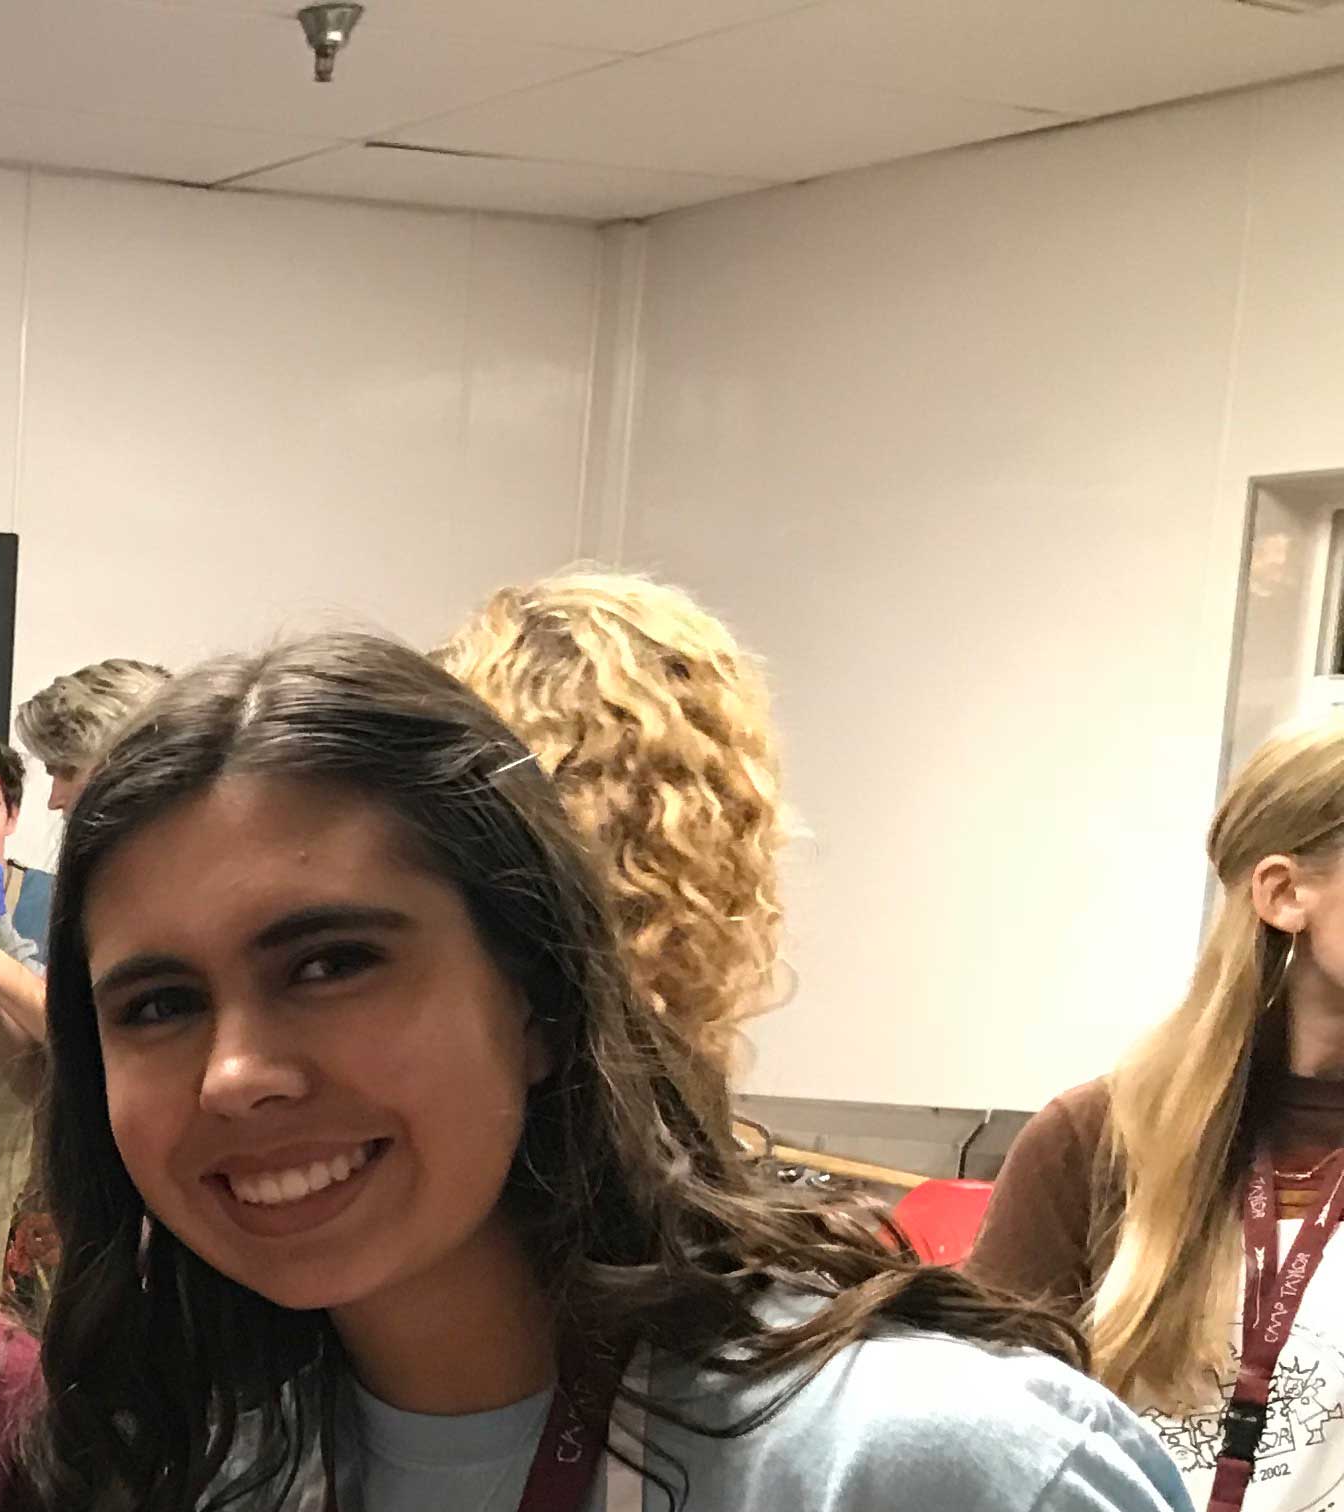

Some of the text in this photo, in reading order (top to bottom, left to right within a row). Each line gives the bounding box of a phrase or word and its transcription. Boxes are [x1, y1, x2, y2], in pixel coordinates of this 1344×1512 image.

[1264, 1252, 1311, 1344] CAMP TAYLOR
[1260, 1462, 1292, 1482] 2002
